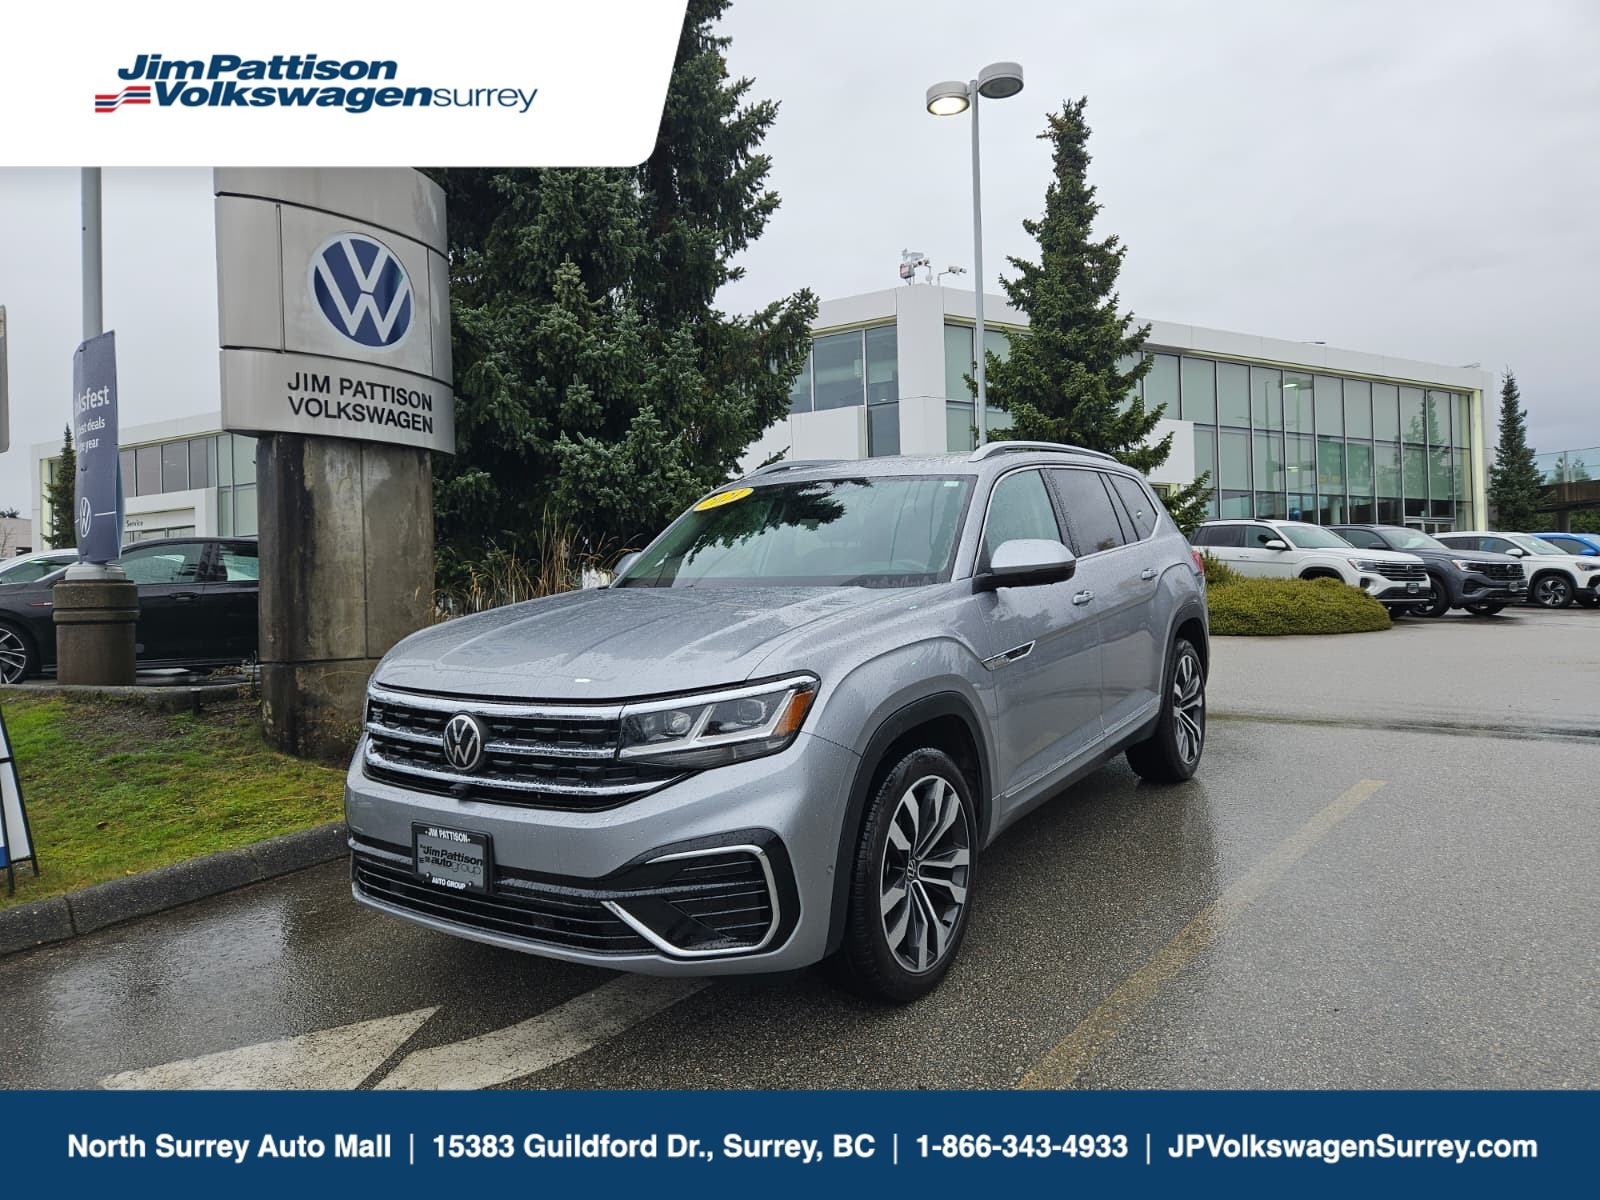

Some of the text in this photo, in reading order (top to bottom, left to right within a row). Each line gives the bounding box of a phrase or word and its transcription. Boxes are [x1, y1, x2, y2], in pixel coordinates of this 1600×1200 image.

[287, 371, 433, 413] JIM PATTISON
[87, 416, 105, 431] deals
[287, 395, 434, 435] VOLKSWAGEN
[439, 830, 468, 843] PATTISON
[423, 846, 483, 866] Jim Pattison
